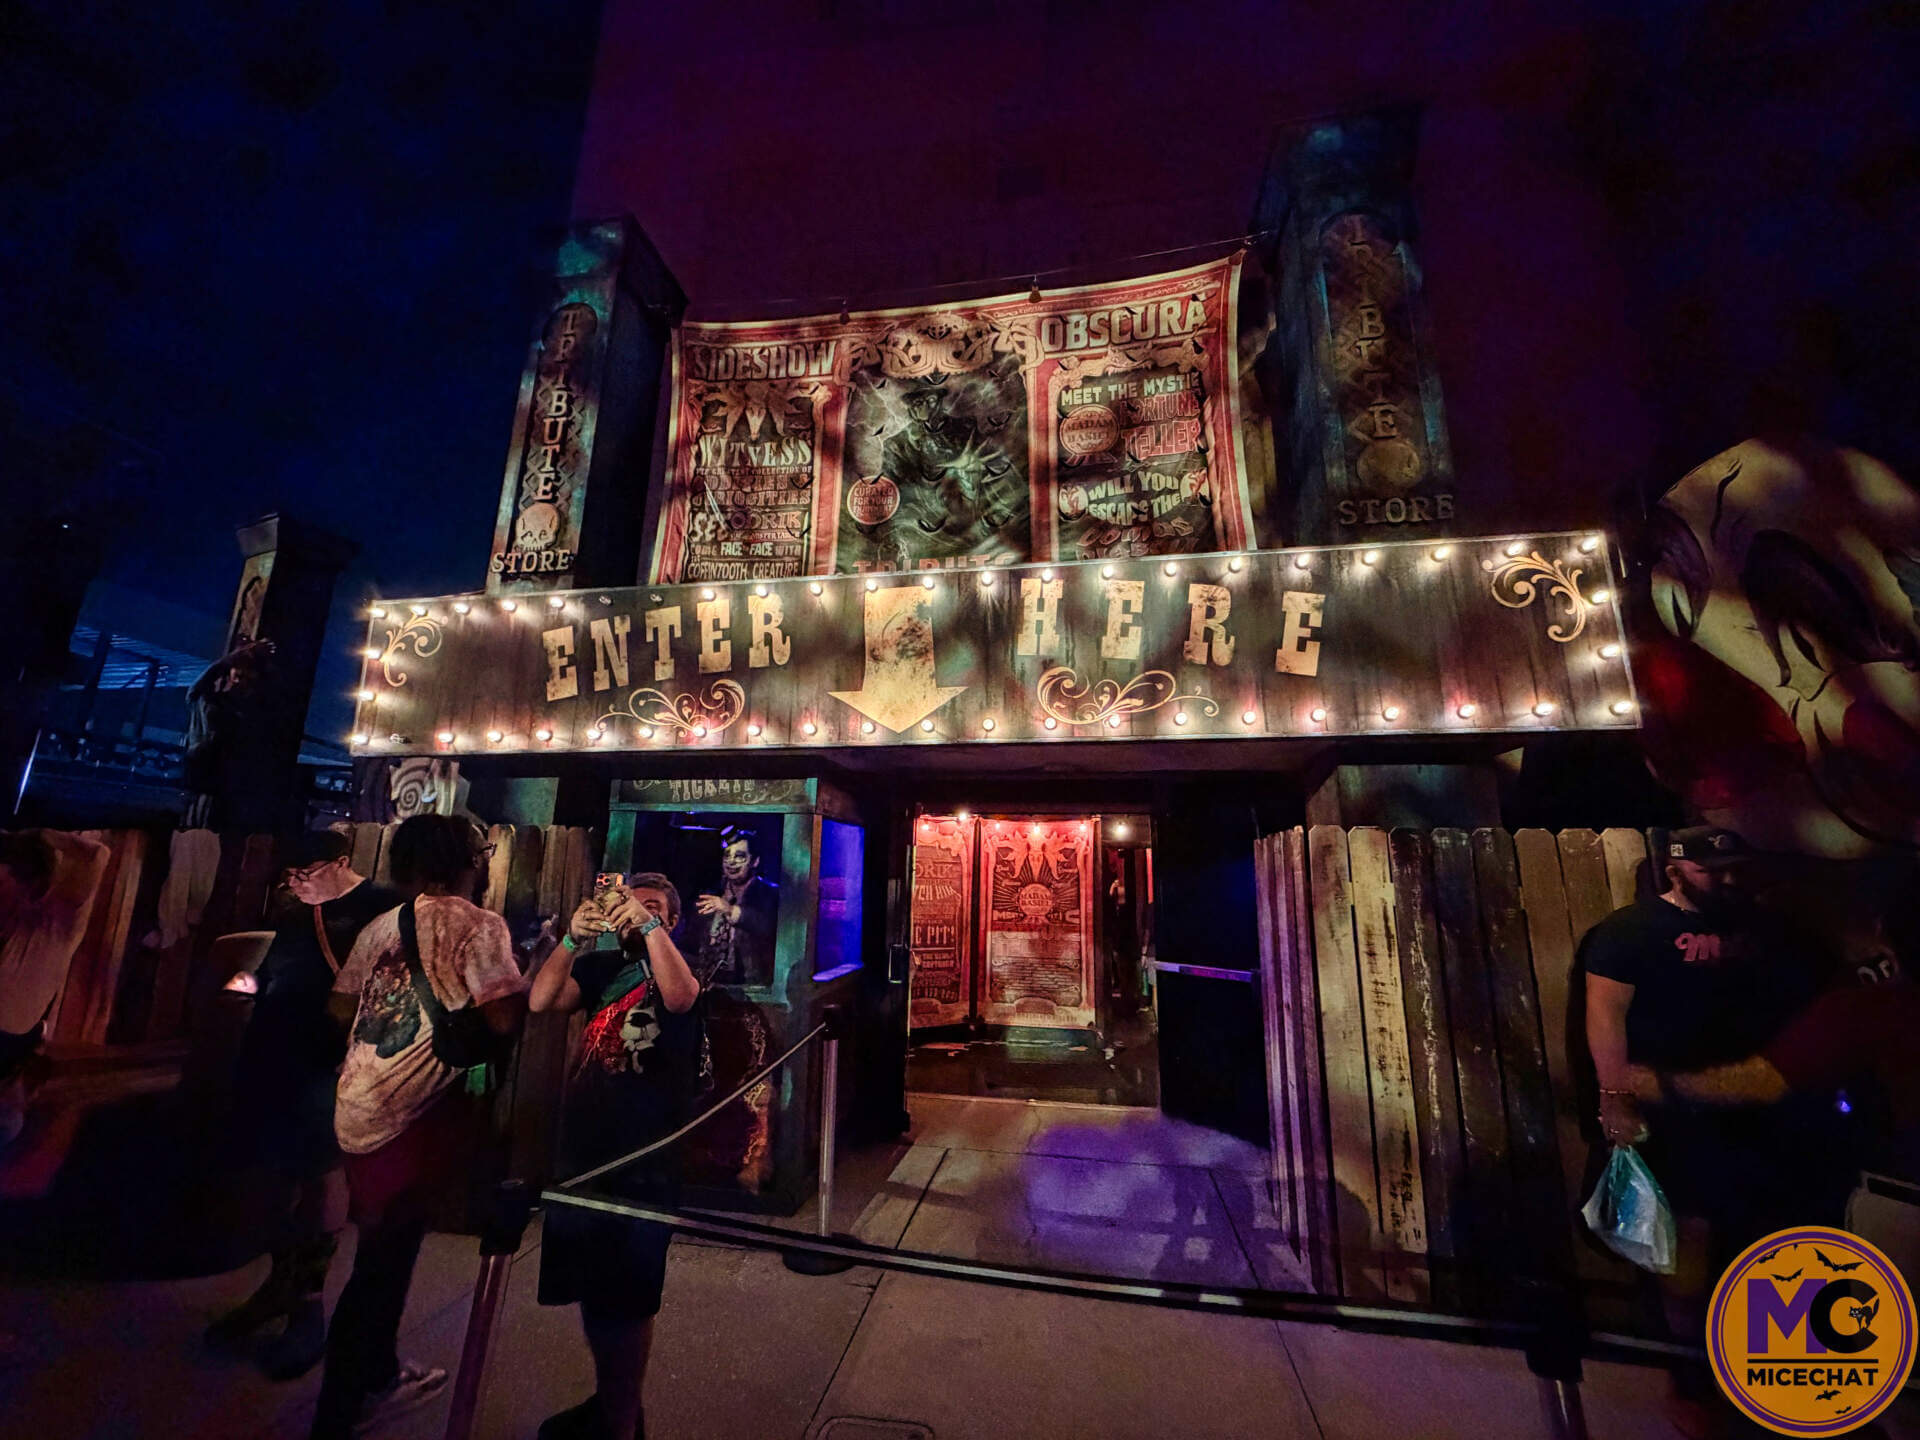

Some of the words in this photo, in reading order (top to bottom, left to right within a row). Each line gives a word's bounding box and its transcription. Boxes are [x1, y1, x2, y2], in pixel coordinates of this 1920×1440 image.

[1041, 299, 1207, 352] OBSCURA
[694, 341, 837, 380] SIDESHOW
[534, 309, 578, 501] TRIBUTE
[1061, 387, 1102, 406] MEET
[1108, 382, 1138, 400] THE
[1119, 389, 1201, 426] FORTUNE
[698, 438, 813, 467] WITNESS
[1121, 418, 1201, 460] TELLER
[1089, 474, 1134, 501] WILL
[1138, 471, 1180, 492] YOU
[1151, 494, 1182, 518] THE
[1338, 493, 1455, 525] STORE
[491, 550, 571, 574] STORE
[720, 542, 743, 556] FACE
[749, 542, 774, 556] FACE
[687, 562, 748, 580] COFFINTOOTH
[752, 562, 800, 579] CREATURE
[543, 593, 791, 702] ENTER
[1017, 578, 1326, 676] HERE
